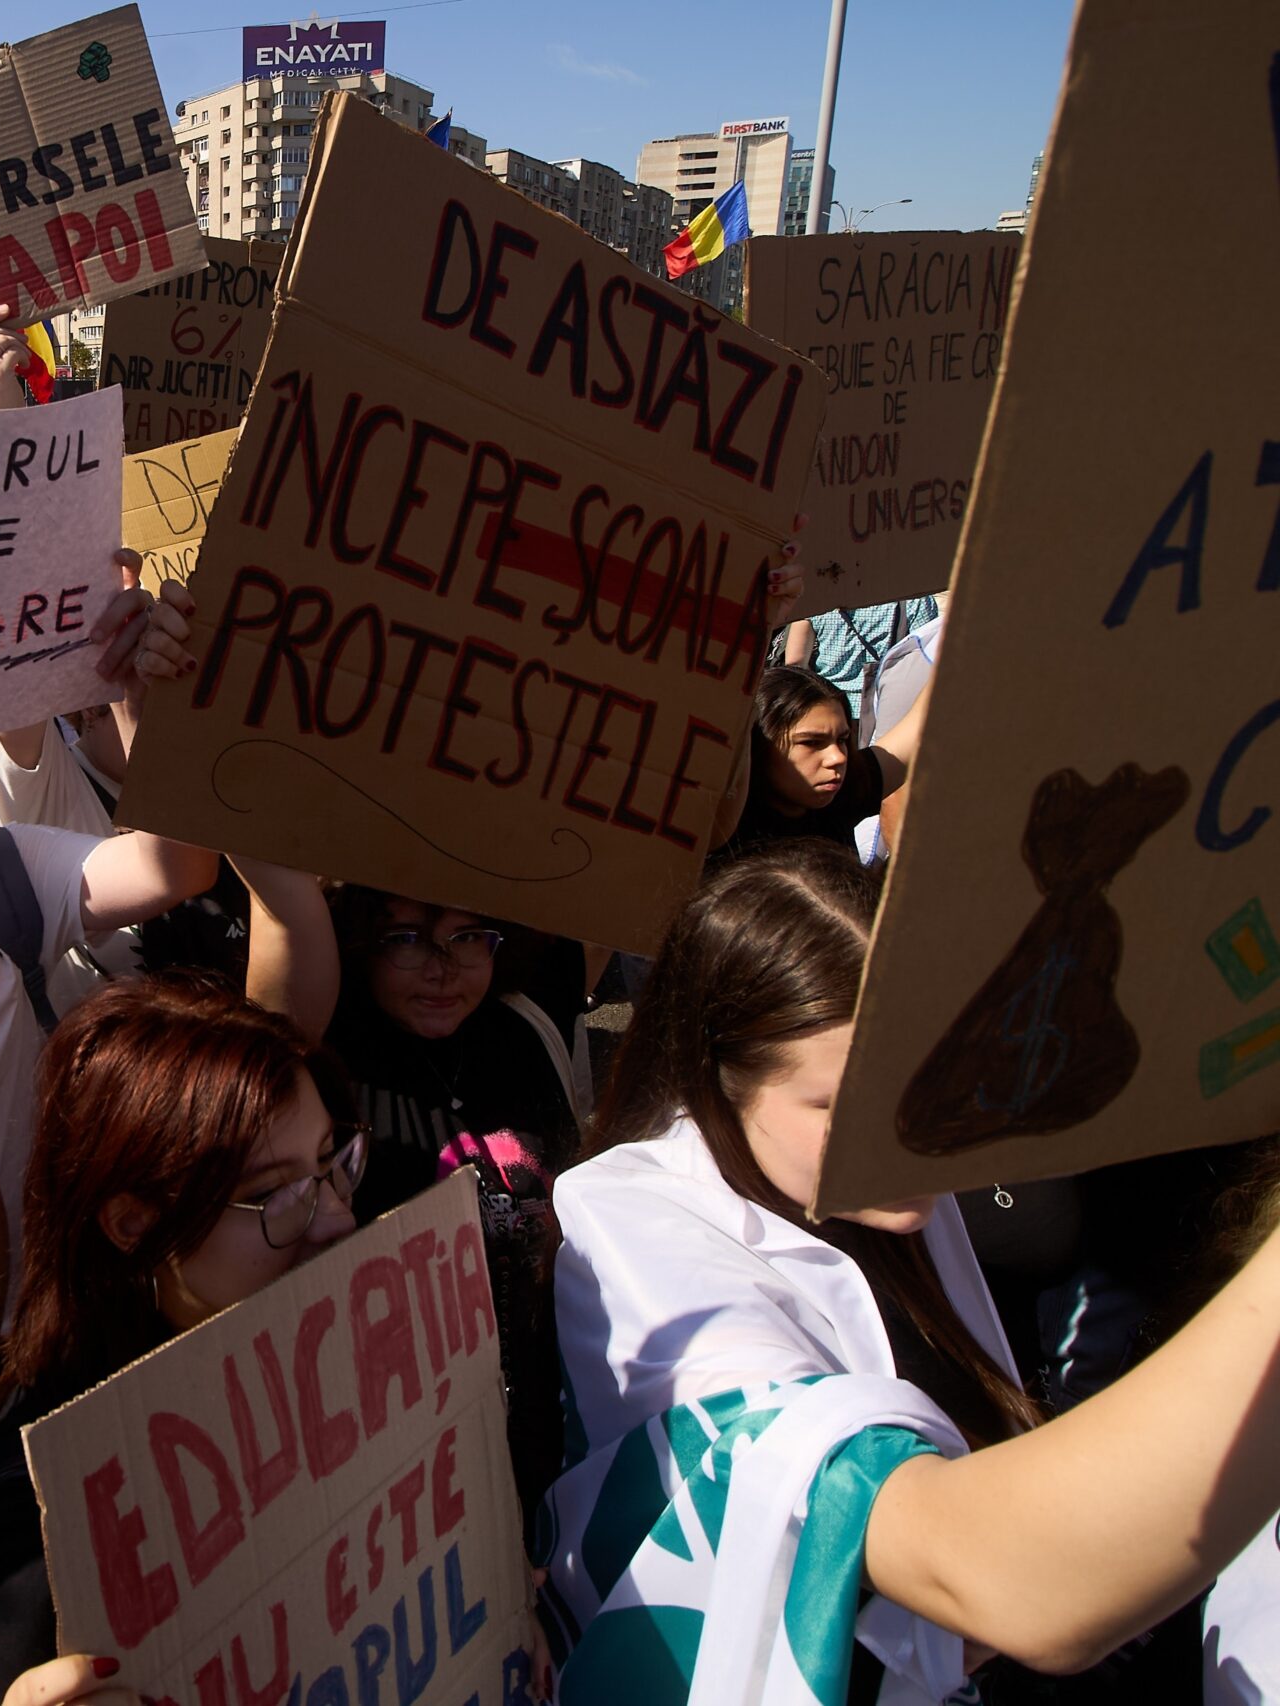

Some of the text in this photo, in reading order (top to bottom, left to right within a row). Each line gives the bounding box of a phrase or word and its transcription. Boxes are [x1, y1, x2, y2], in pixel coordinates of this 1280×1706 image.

[256, 42, 373, 66] ENAYATI
[723, 120, 786, 135] FIRSTBANK
[422, 199, 538, 358] DE
[816, 242, 972, 328] SĂRĂCIA
[105, 353, 154, 390] DAR
[883, 336, 917, 385] SA
[929, 332, 965, 383] FIE
[972, 332, 1003, 381] CR
[883, 390, 908, 425] DE
[239, 371, 560, 620] ÎNCEPE
[848, 476, 972, 544] UNIVERS
[191, 565, 733, 852] PROTESTELE
[324, 1425, 465, 1636] ESTE
